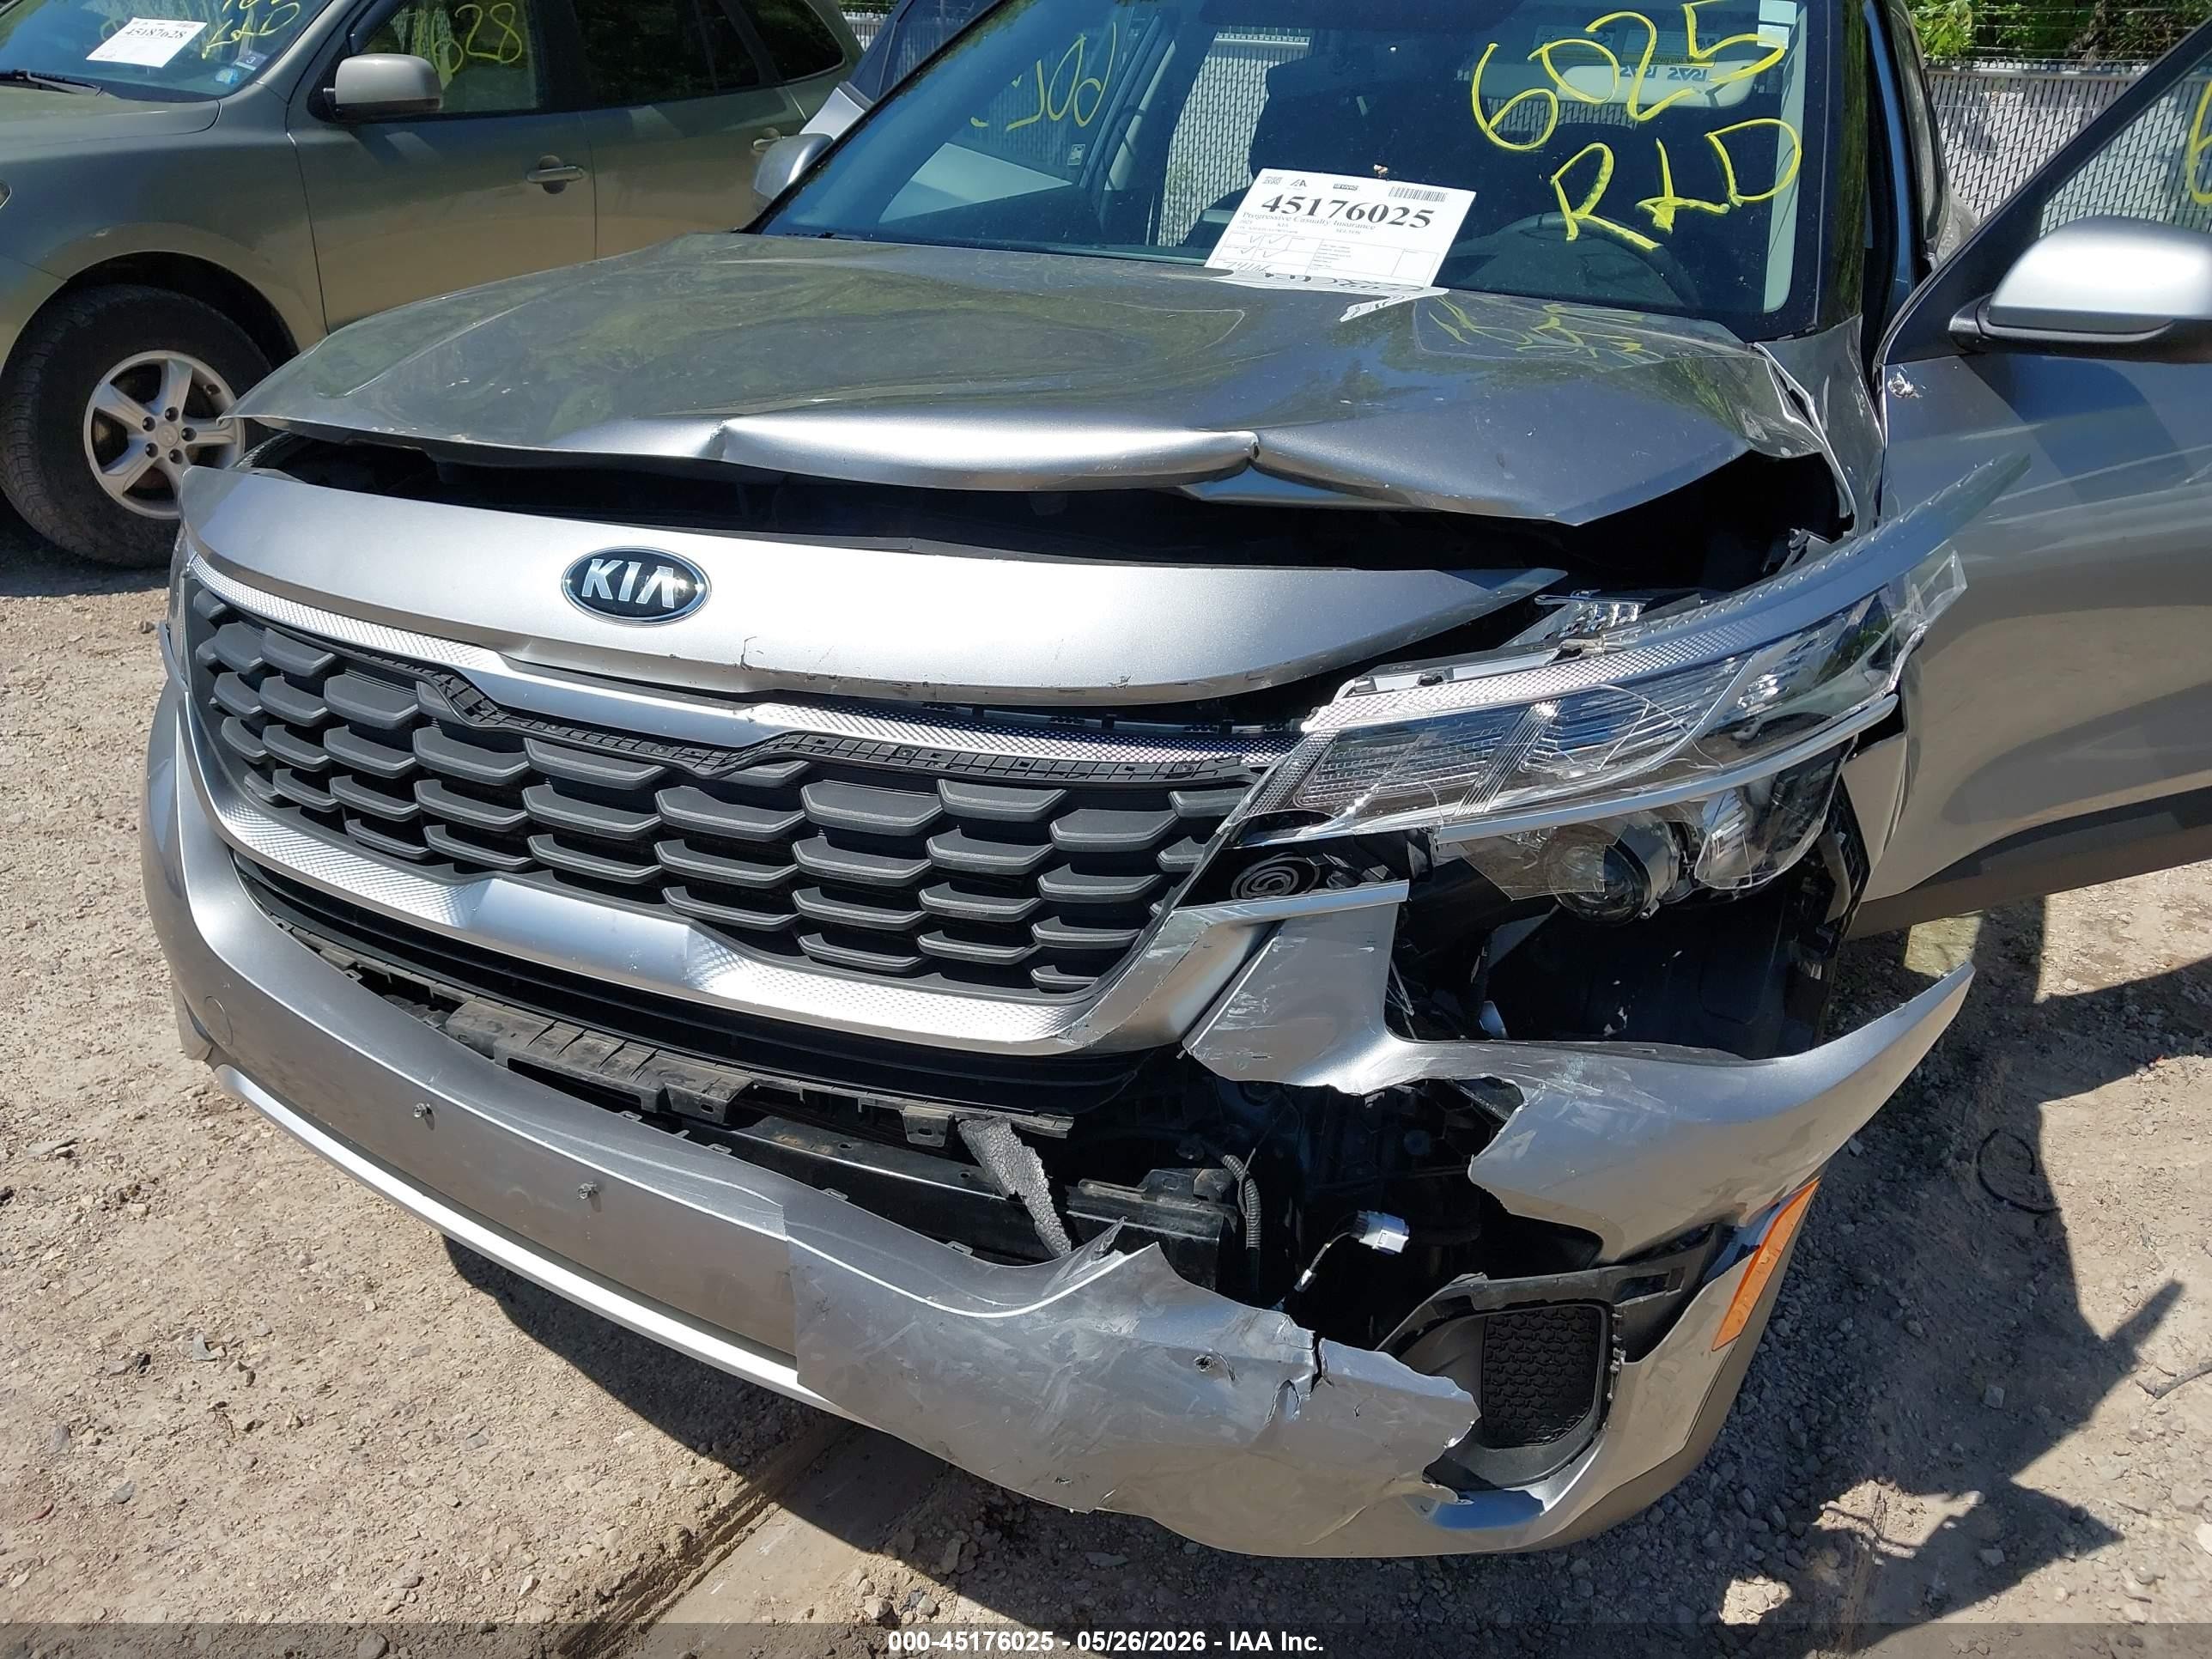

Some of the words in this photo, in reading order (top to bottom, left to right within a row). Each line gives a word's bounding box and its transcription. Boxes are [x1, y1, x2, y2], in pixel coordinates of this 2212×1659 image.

[1472, 0, 1786, 151] 6025
[1243, 211, 1291, 222] Progressive
[1293, 216, 1331, 227] Casualty
[1334, 219, 1376, 230] Insurance
[1261, 193, 1435, 228] 45176025
[581, 558, 675, 609] KIA
